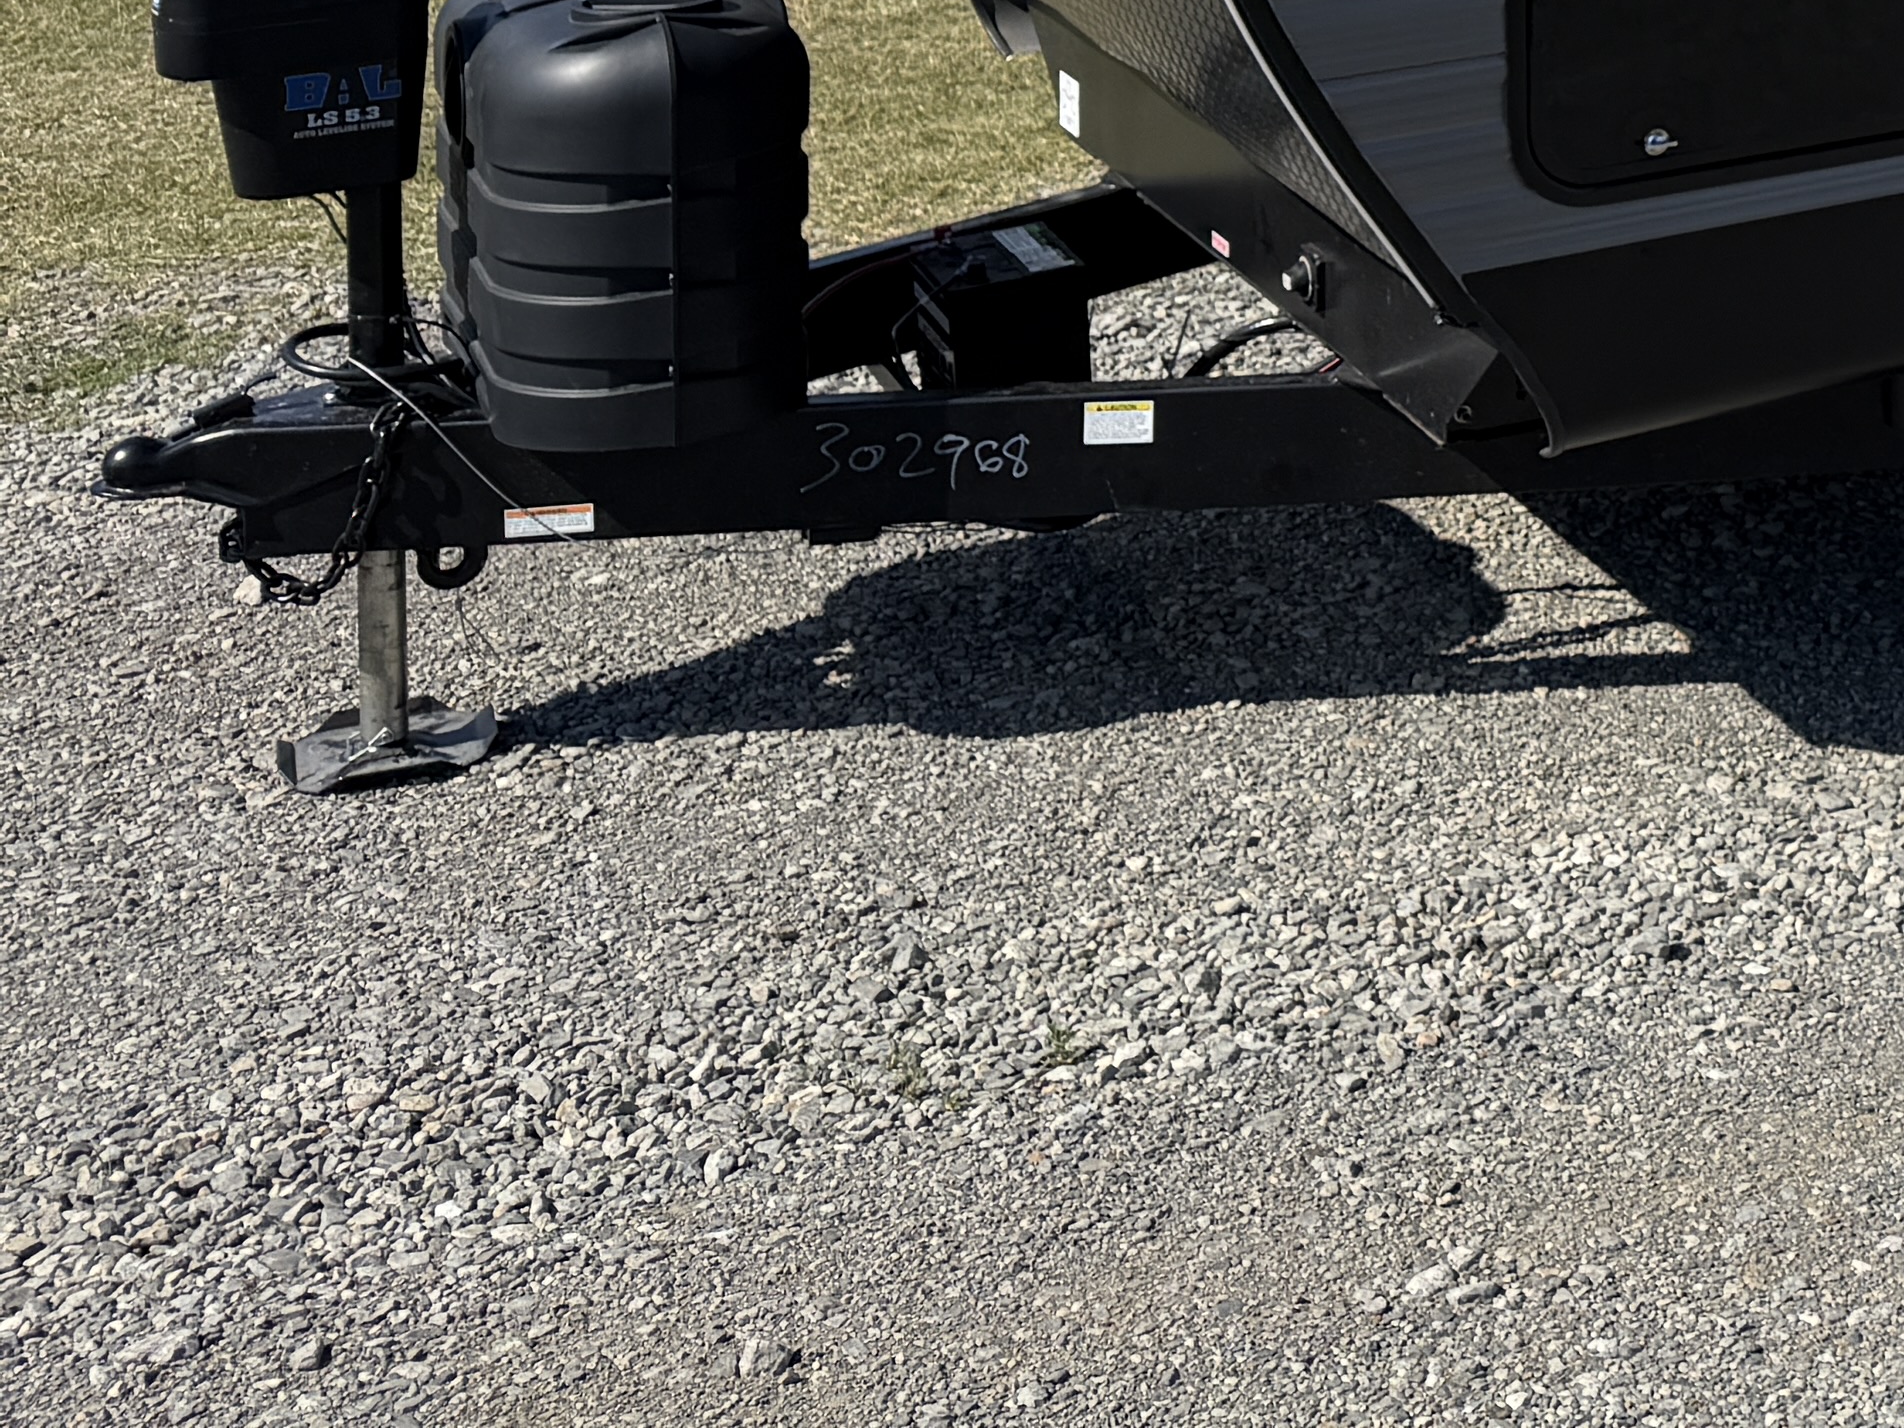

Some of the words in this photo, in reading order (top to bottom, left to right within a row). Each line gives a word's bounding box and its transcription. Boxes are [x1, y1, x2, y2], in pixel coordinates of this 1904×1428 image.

[284, 64, 402, 111] BAL
[307, 110, 339, 128] LS
[800, 422, 1030, 493] 302968
